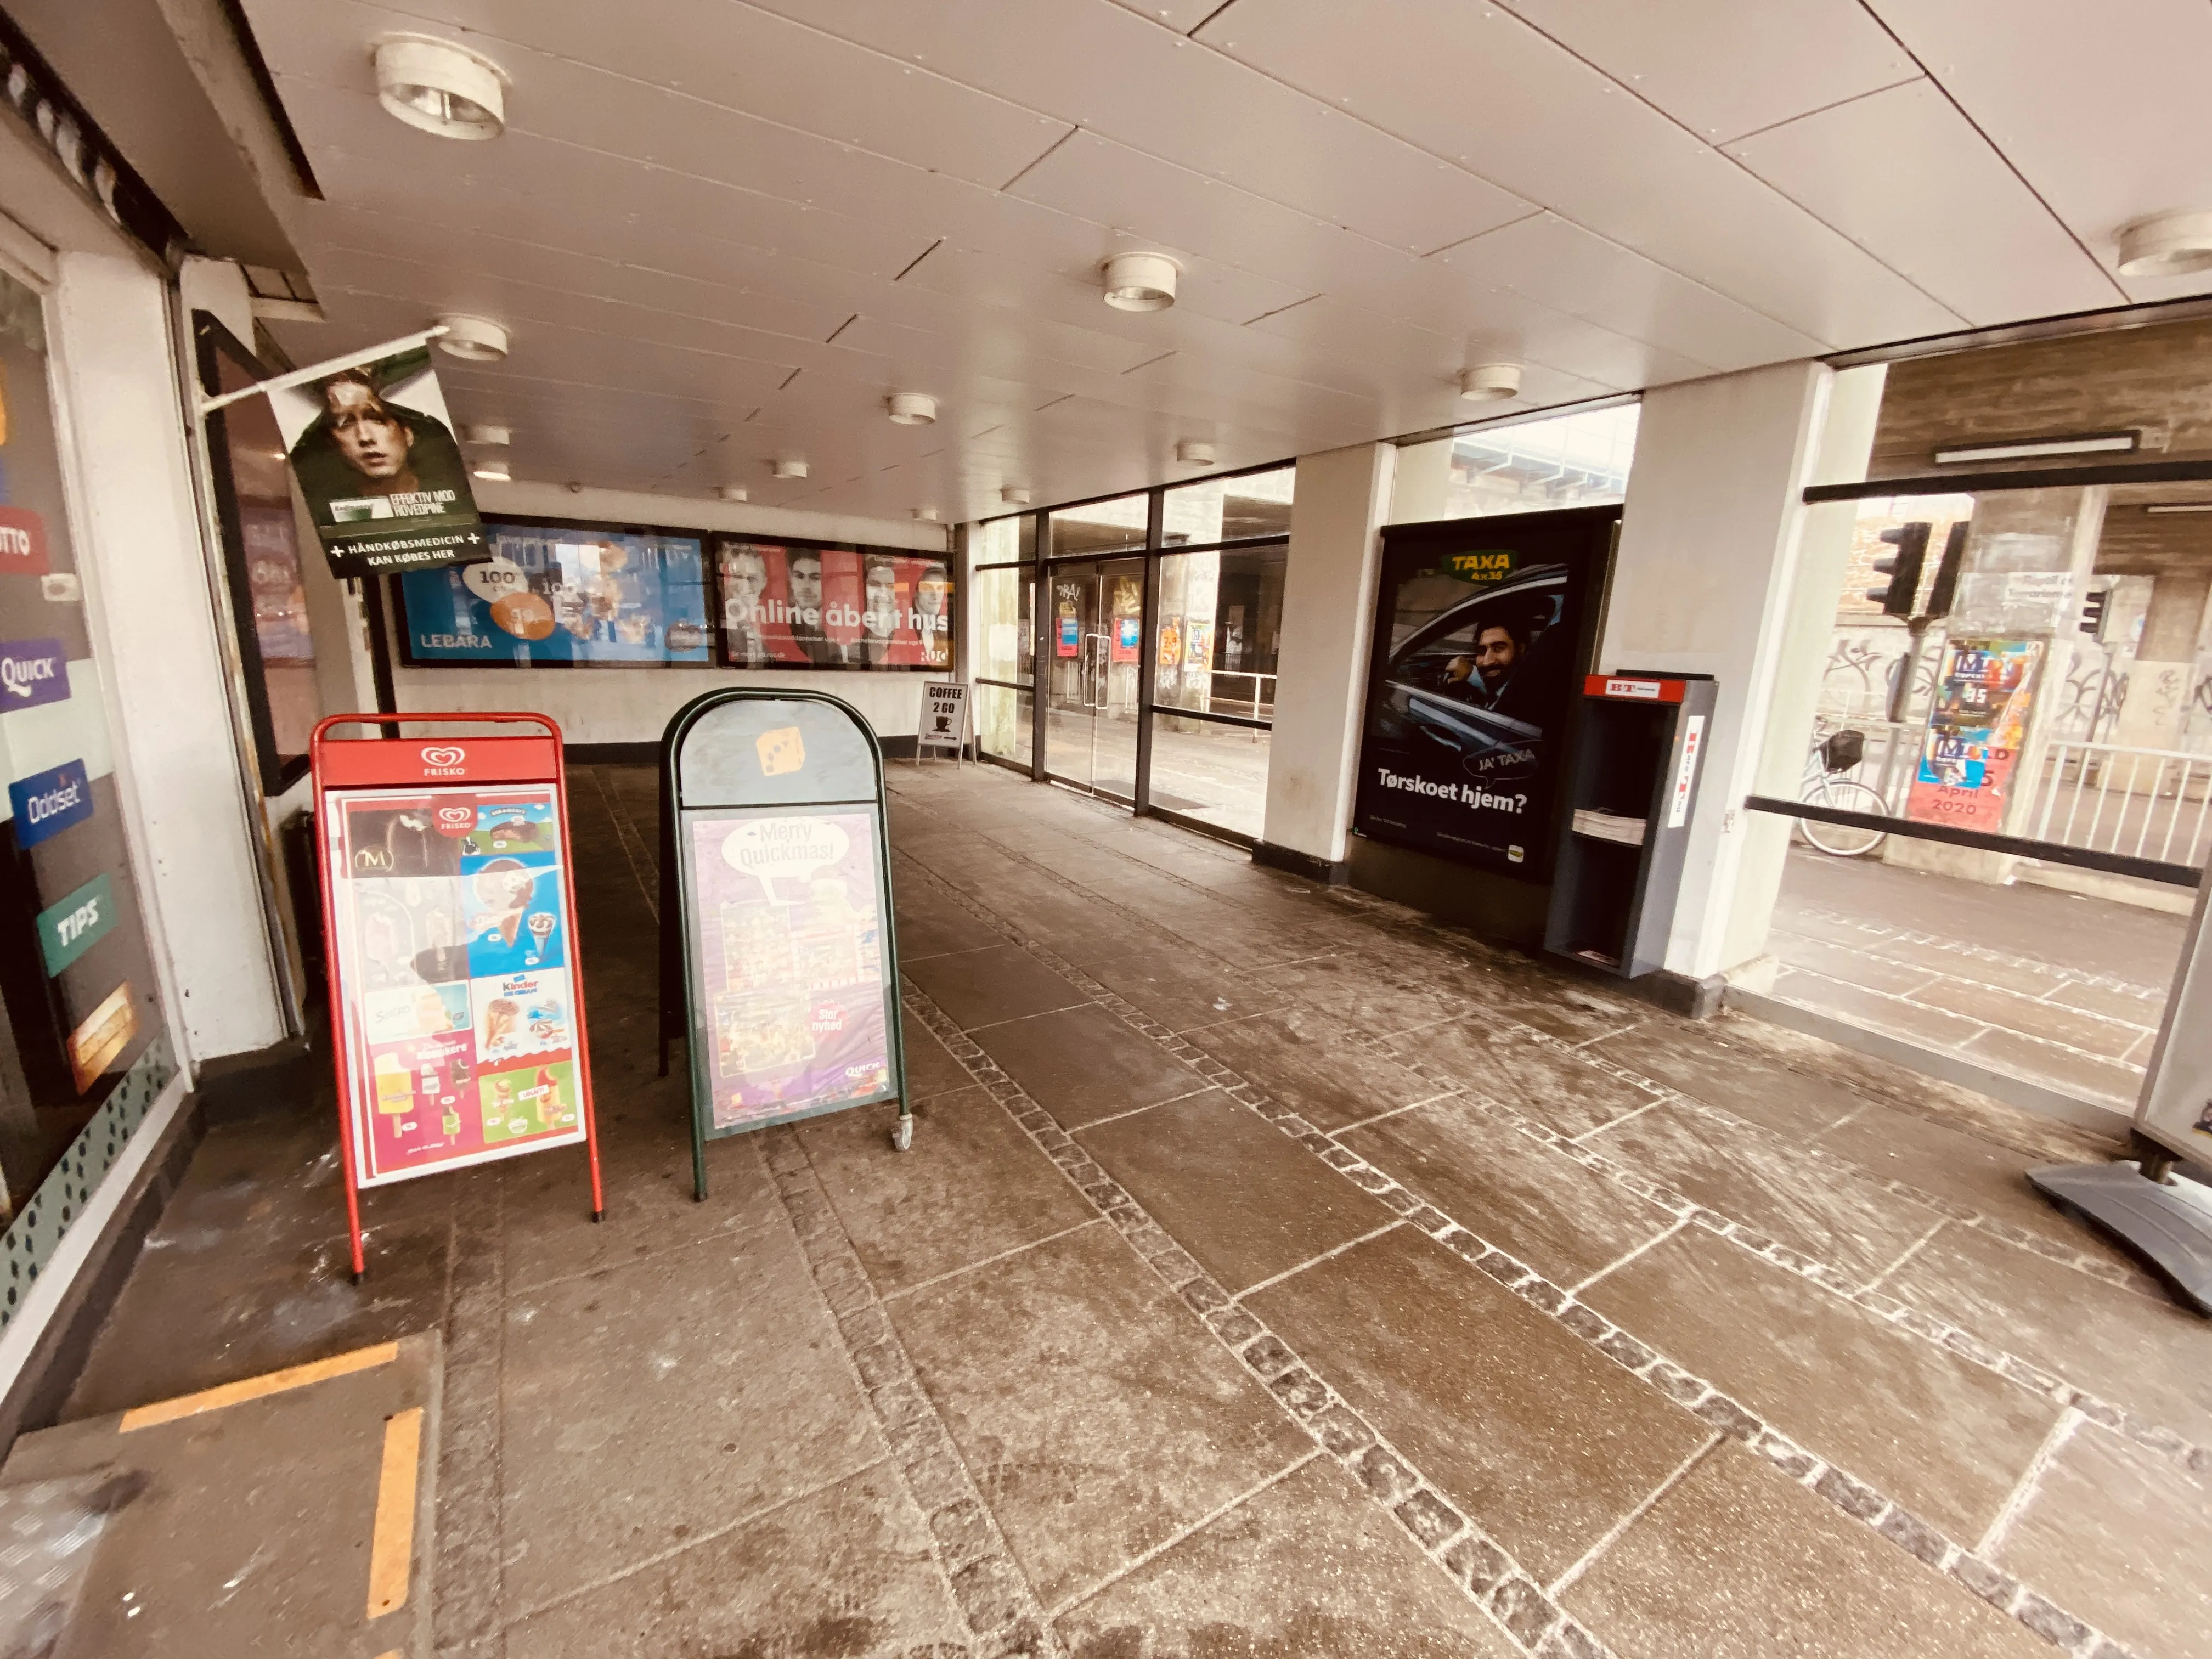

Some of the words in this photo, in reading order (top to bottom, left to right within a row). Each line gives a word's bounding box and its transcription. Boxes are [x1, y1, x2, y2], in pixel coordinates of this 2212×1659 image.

[390, 493, 432, 505] EFFEKTIV
[433, 490, 455, 503] MOD
[393, 503, 446, 516] HOVEDPINE
[348, 535, 464, 554] HÅNDKØBSMEDICIN
[367, 555, 393, 566] KAN
[395, 551, 431, 563] KØBES
[433, 550, 455, 560] HER
[1452, 554, 1510, 570] TAXA
[479, 571, 515, 584] 100
[725, 597, 820, 625] Online
[908, 607, 948, 631] hus
[421, 634, 493, 648] LEBARA
[2, 657, 54, 697] QUICK
[929, 687, 962, 699] COFFEE
[933, 702, 940, 712] 2
[941, 703, 955, 713] GO
[1497, 749, 1536, 766] TAXA
[424, 768, 465, 776] FRISKO
[1378, 768, 1458, 800] Tørskoet
[1462, 784, 1527, 814] hjem?
[1937, 786, 1979, 798] April
[27, 781, 81, 823] Oddset
[1932, 799, 1977, 815] 2020
[759, 823, 812, 842] Merry
[740, 842, 834, 869] Quickmas!
[57, 896, 100, 947] TIPS
[819, 1008, 837, 1020] Stor
[812, 1020, 842, 1034] nyhed
[845, 1061, 880, 1077] QUICK
